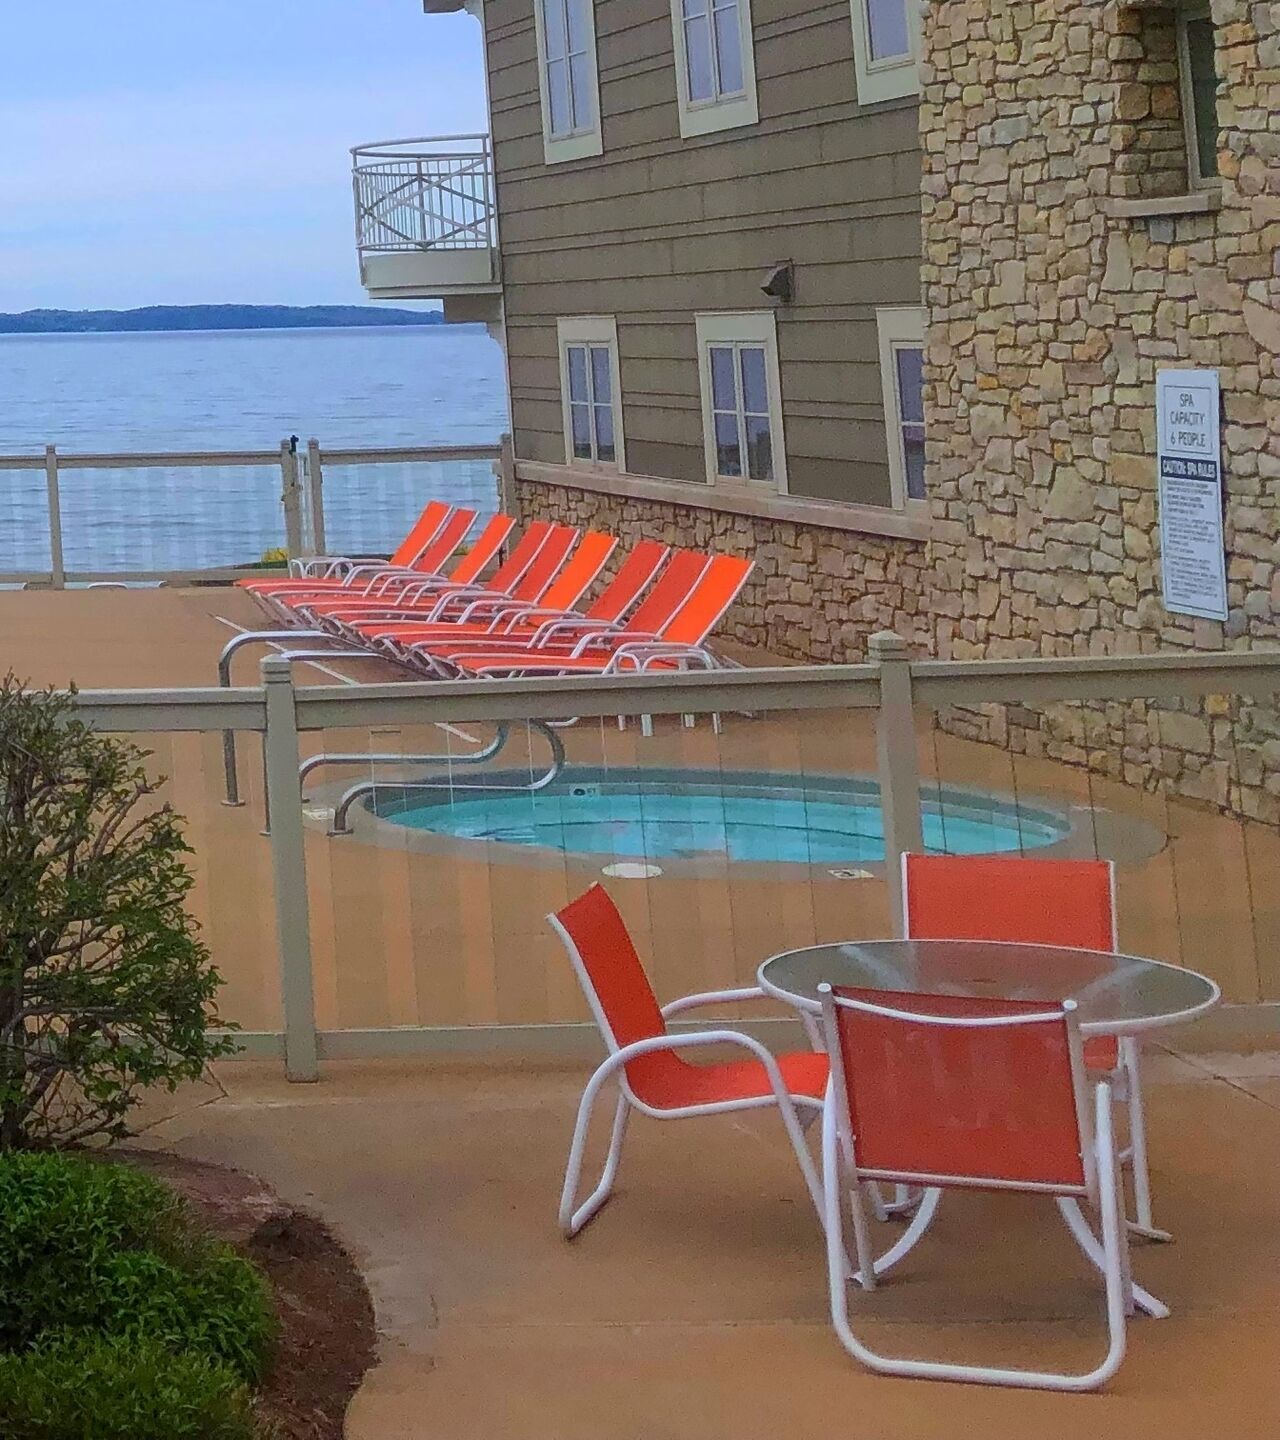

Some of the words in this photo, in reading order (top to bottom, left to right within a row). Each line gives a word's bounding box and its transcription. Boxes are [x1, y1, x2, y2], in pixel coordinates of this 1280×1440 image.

[1180, 393, 1195, 407] SPA
[1170, 411, 1205, 426] CAPACITY
[1170, 431, 1176, 445] 6
[1178, 431, 1206, 447] PEOPLE
